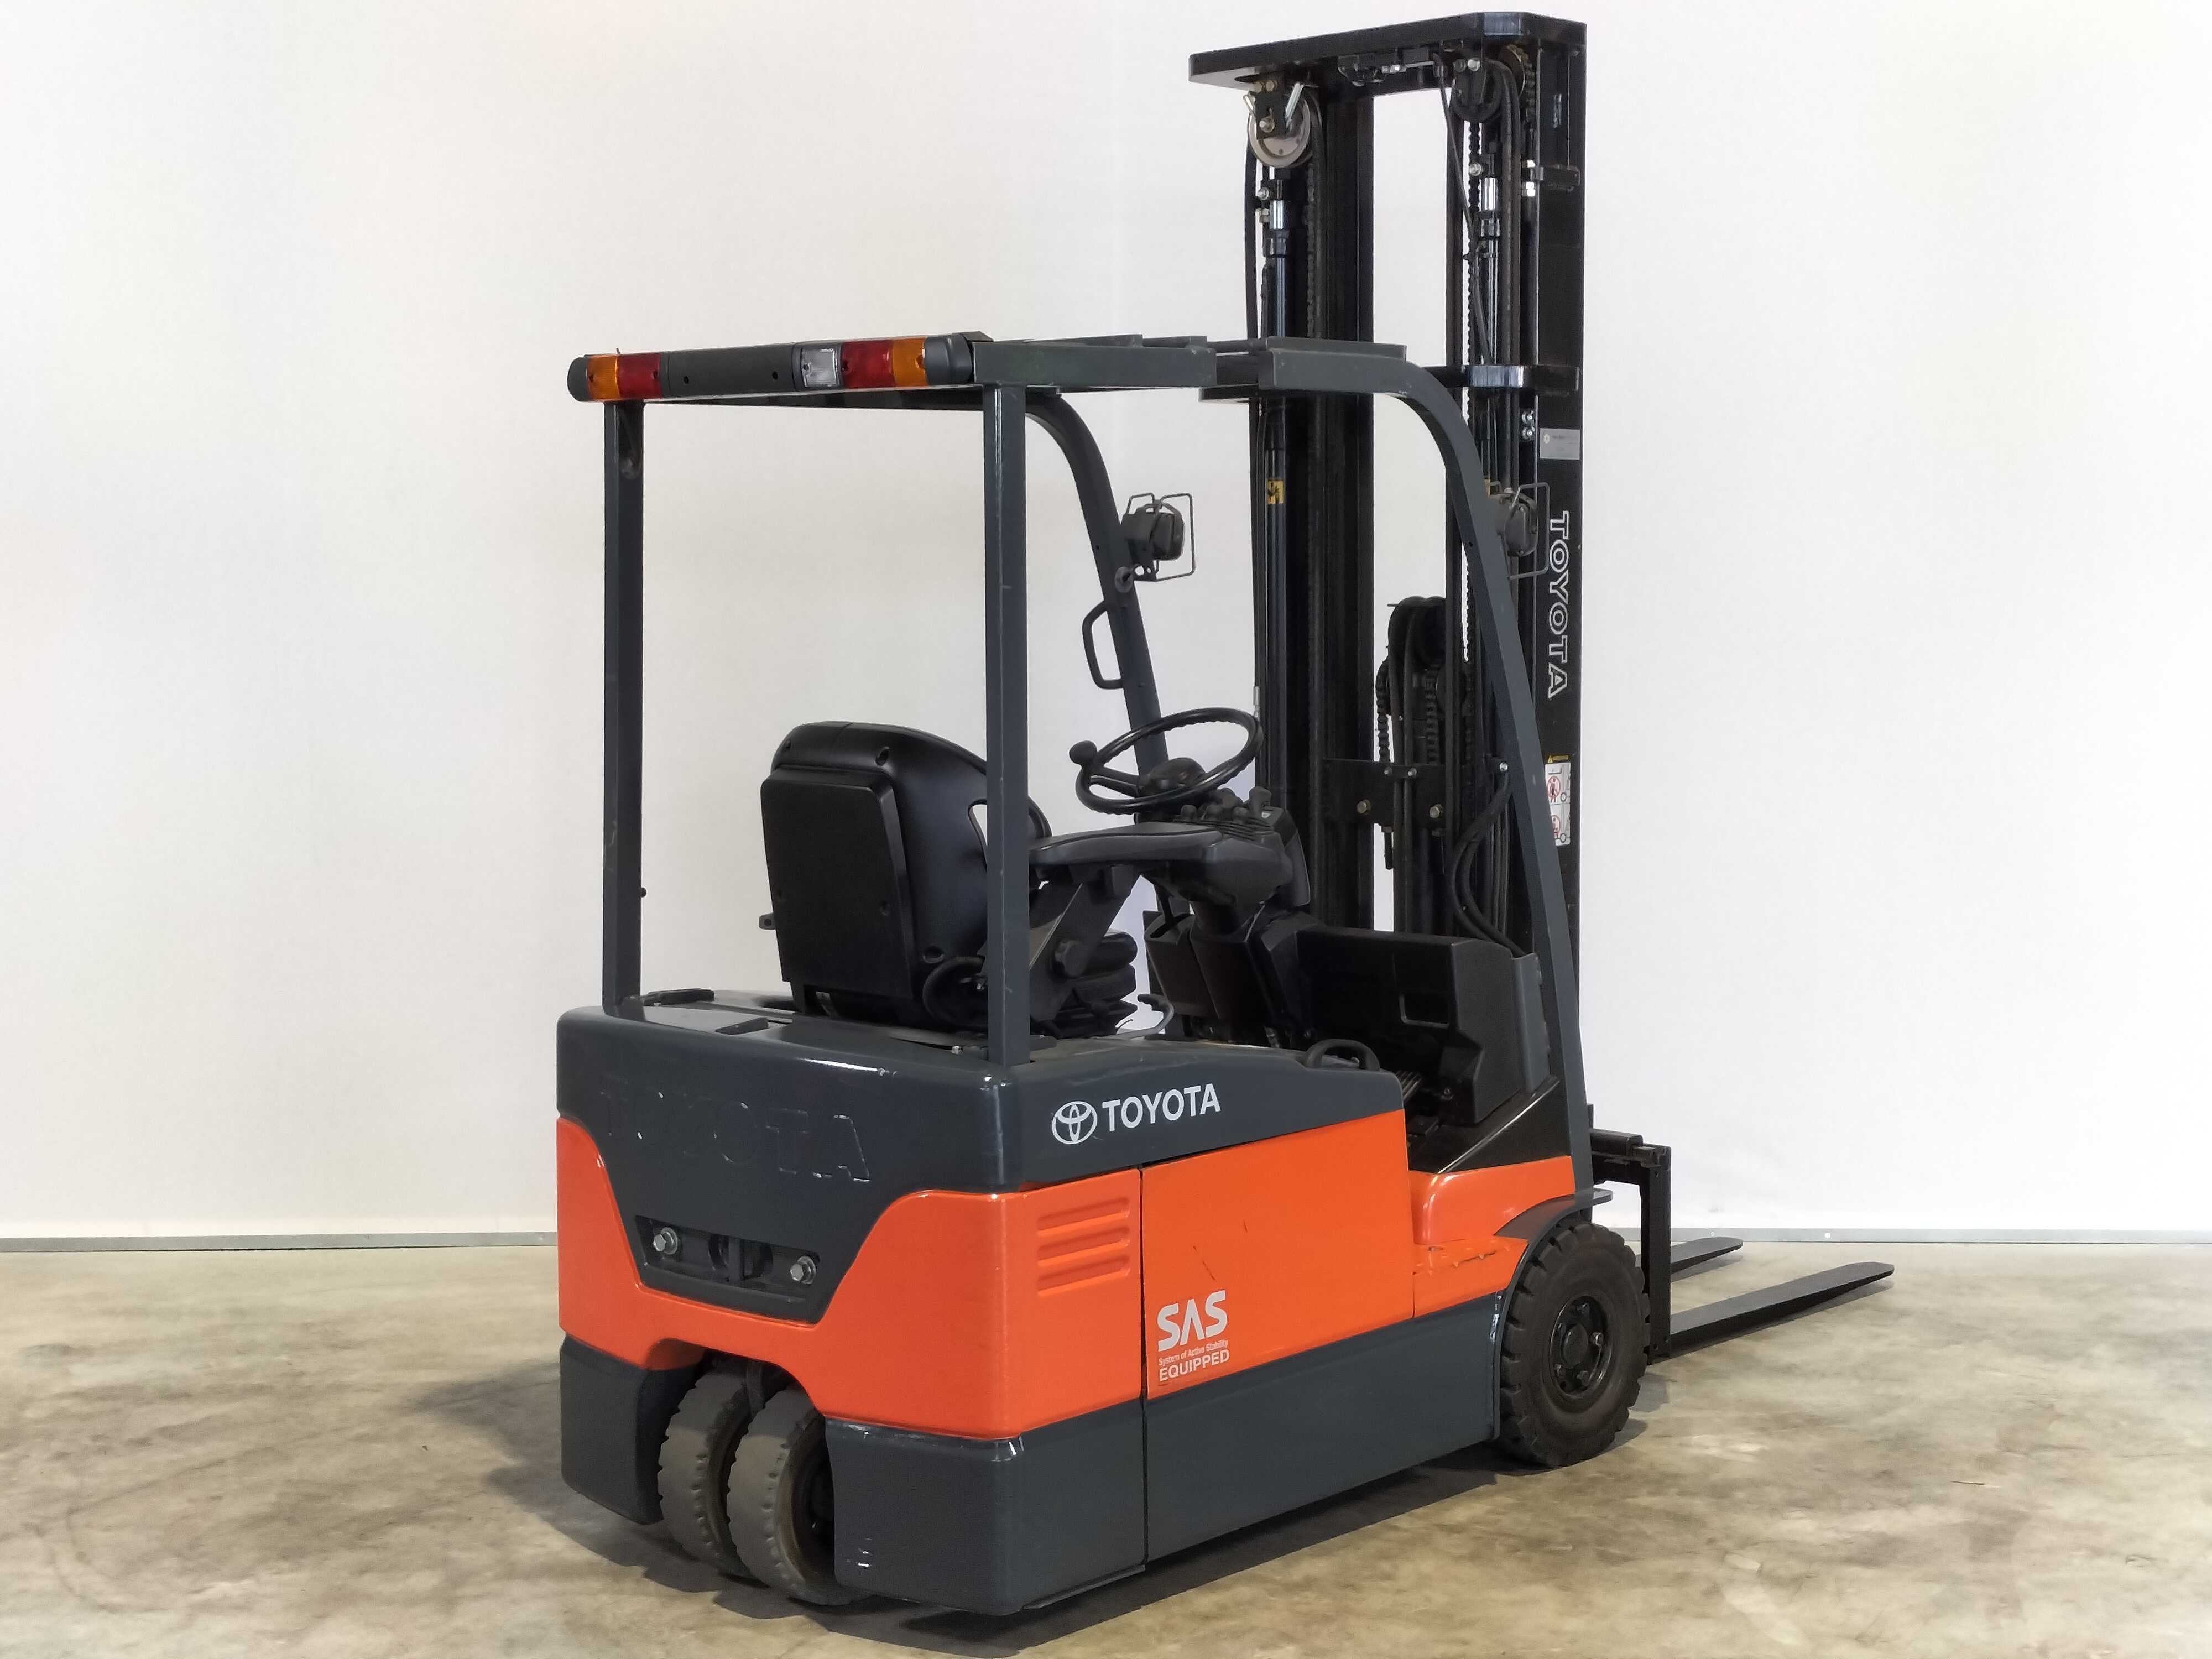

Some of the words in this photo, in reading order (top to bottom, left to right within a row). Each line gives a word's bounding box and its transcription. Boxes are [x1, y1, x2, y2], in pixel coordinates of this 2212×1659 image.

[1548, 510, 1569, 700] TOYOTA
[1102, 1083, 1221, 1131] TOYOTA
[1157, 1289, 1228, 1352] SAS
[1159, 1354, 1180, 1366] System
[1181, 1350, 1187, 1359] of
[1187, 1346, 1205, 1357] Active
[1206, 1339, 1228, 1352] Stability
[1159, 1349, 1230, 1381] EQUIPPED
